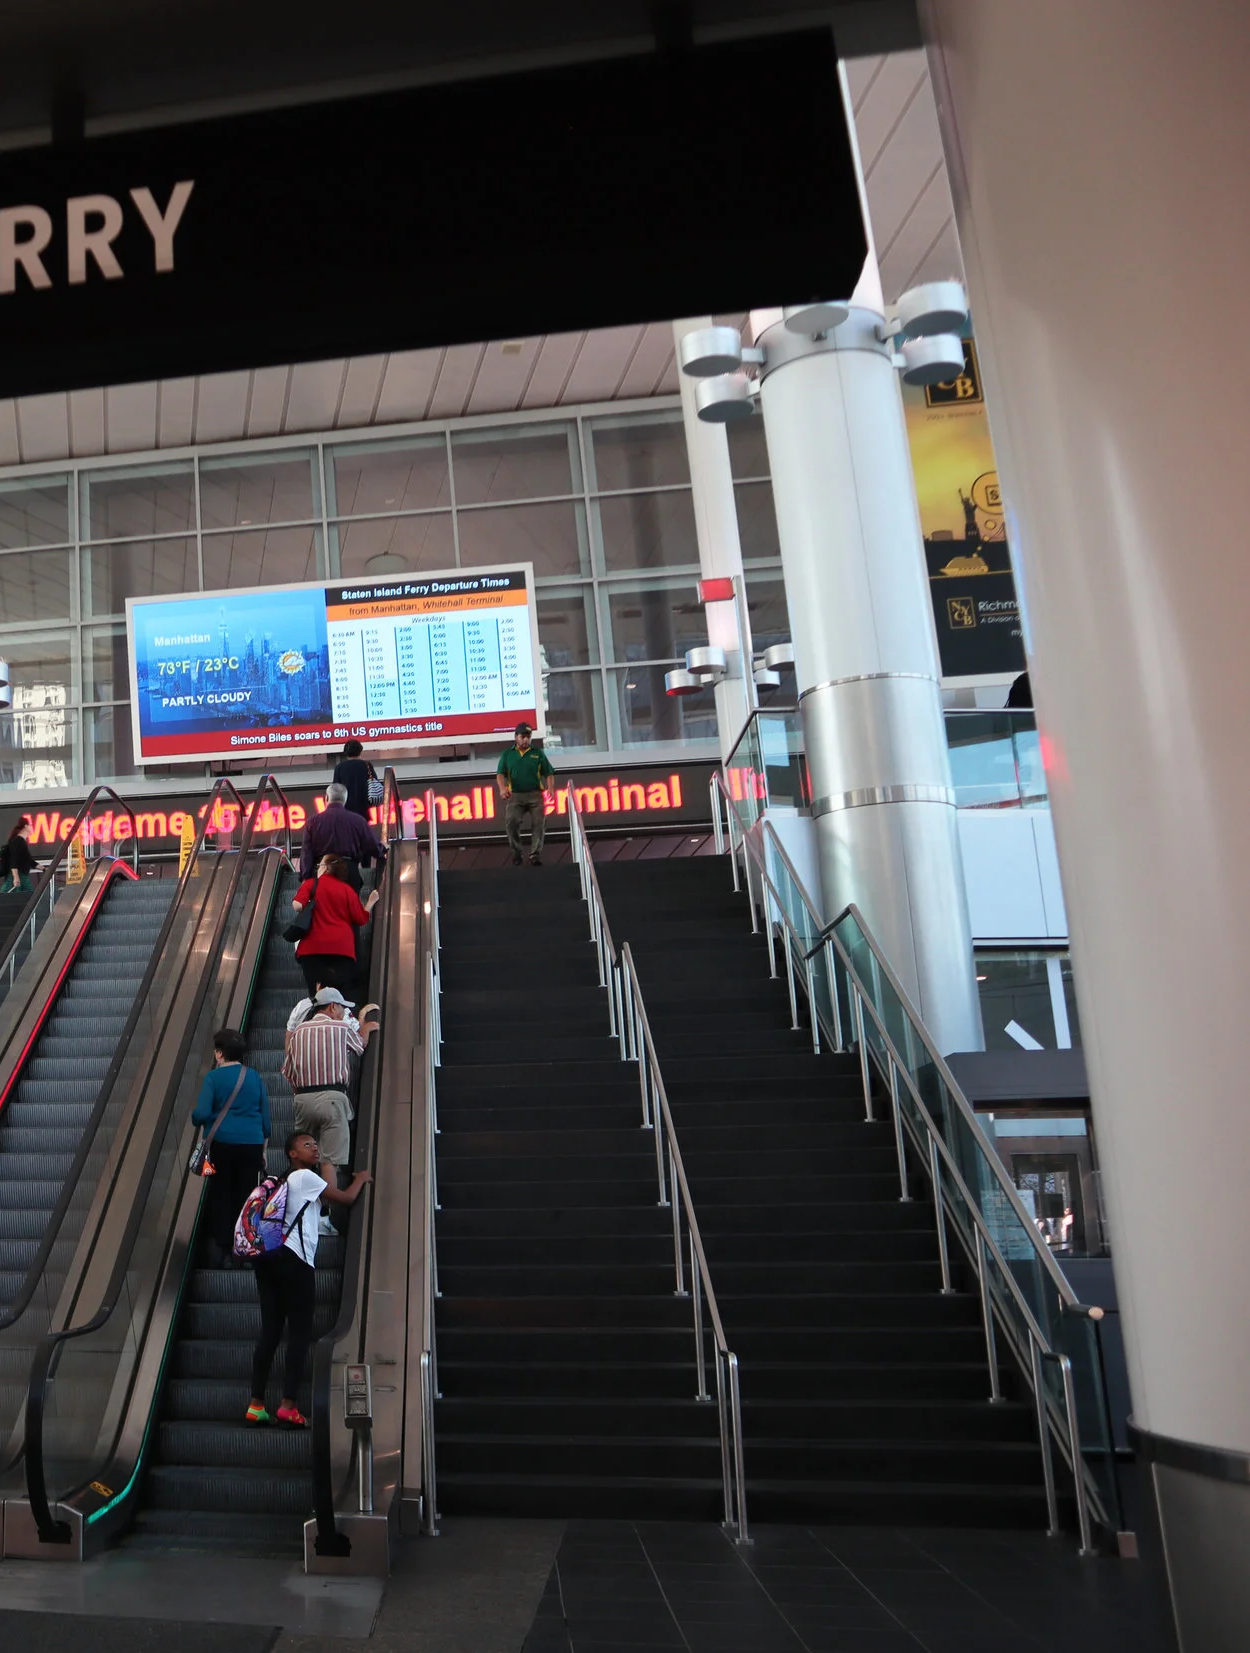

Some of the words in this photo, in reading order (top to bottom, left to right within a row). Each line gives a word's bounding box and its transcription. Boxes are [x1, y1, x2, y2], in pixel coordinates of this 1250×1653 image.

[342, 590, 372, 600] Staten
[374, 587, 402, 598] Island
[405, 584, 430, 595] Ferry
[432, 580, 478, 592] Departure
[481, 578, 510, 588] Times
[350, 607, 368, 616] from
[371, 604, 420, 614] Manhattan,
[423, 598, 463, 609] Whitehall
[466, 595, 504, 606] Terminal
[412, 616, 446, 624] Weekdays
[988, 616, 1013, 624] Division
[154, 633, 210, 646] Manhattan
[158, 660, 190, 676] 73°F
[204, 656, 240, 672] 23°C
[162, 694, 204, 708] PARTLY
[207, 691, 252, 704] CLOUDY
[230, 734, 266, 746] Simone
[268, 732, 292, 743] Biles
[294, 732, 320, 741] soars
[322, 730, 332, 739] to
[334, 728, 348, 738] 6th
[351, 726, 366, 736] US
[368, 723, 422, 738] gymnastics
[425, 722, 442, 731] title
[543, 774, 683, 816] rminal
